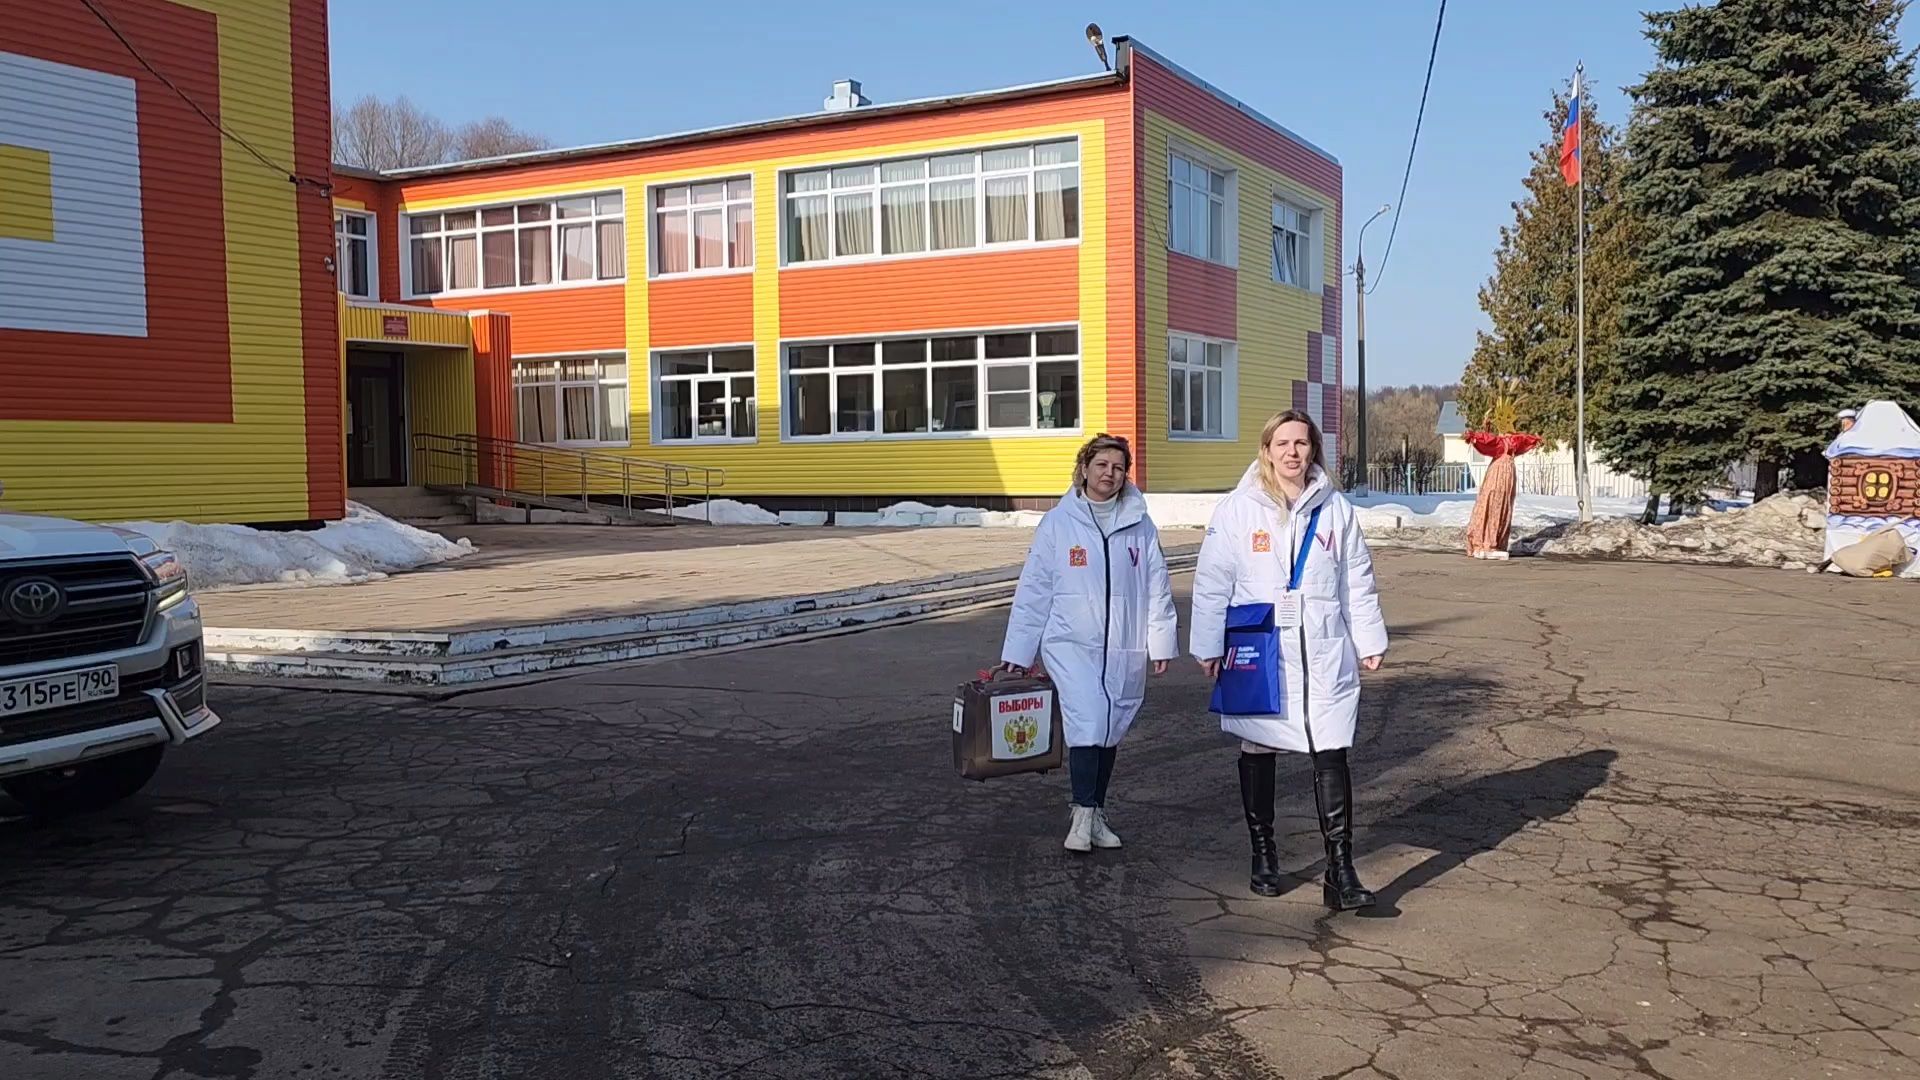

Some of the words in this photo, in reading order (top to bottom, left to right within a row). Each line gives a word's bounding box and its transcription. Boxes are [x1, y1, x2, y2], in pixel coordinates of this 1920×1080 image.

[0, 681, 77, 712] 315РЕ
[80, 669, 111, 692] 790
[87, 689, 104, 697] RUS
[998, 695, 1044, 714] ВЫБОРЫ
